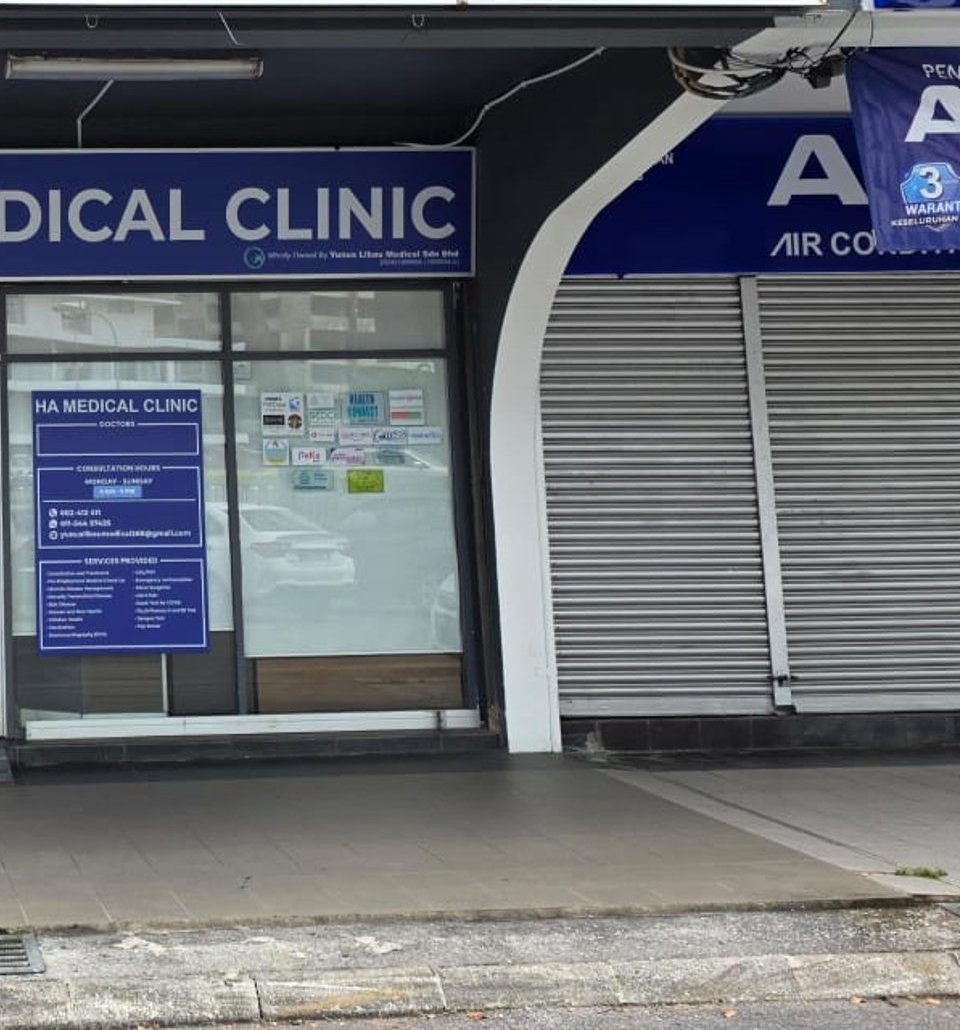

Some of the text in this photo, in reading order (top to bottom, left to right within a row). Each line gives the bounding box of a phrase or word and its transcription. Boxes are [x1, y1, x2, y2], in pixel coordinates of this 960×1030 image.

[919, 166, 944, 199] 3
[225, 186, 455, 241] CLINIC
[770, 232, 823, 257] AIR
[35, 398, 198, 413] HA MEDICAL CLINIC
